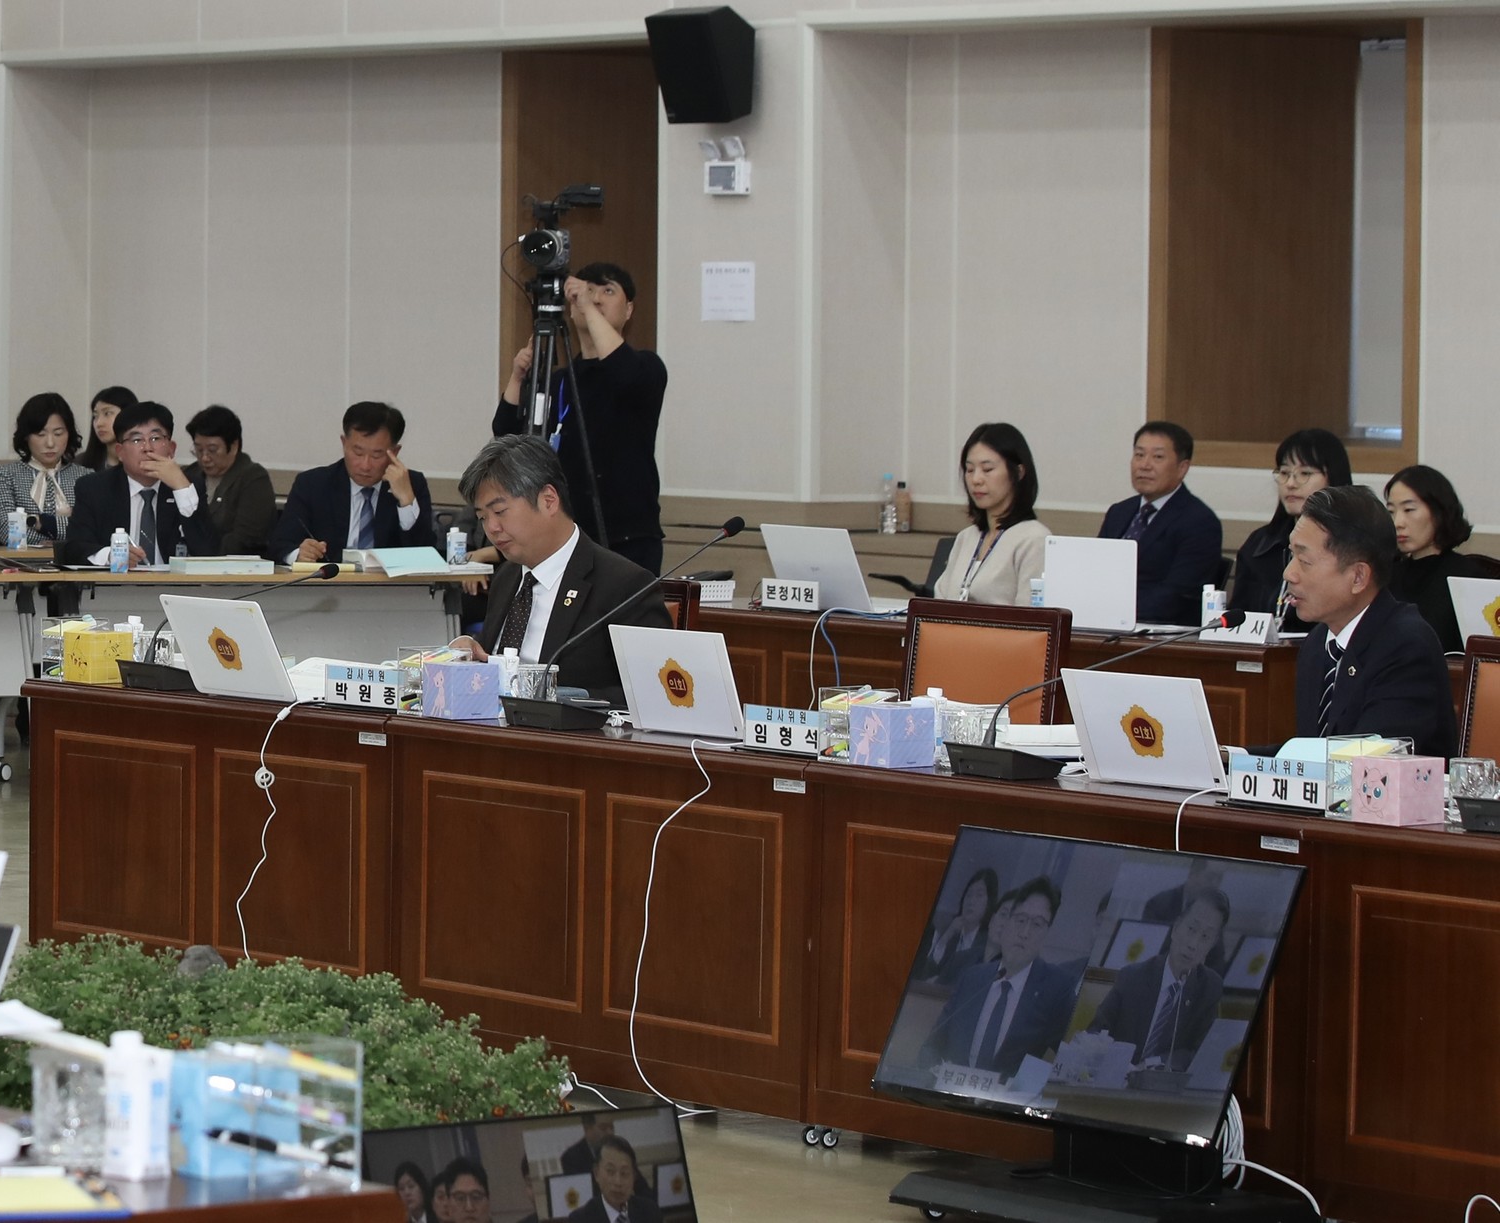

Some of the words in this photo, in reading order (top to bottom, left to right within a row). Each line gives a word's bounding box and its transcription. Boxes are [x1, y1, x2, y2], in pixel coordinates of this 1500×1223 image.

[766, 585, 814, 603] 본청지원
[346, 667, 385, 683] 감사위원
[669, 678, 687, 691] 의회
[335, 682, 396, 706] 박원종
[766, 708, 807, 725] 감사위원
[754, 724, 818, 749] 임형석
[1133, 725, 1155, 740] 의회
[1256, 757, 1305, 776] 감사위원
[1242, 774, 1319, 804] 이재태
[943, 1069, 993, 1092] 부교육감
